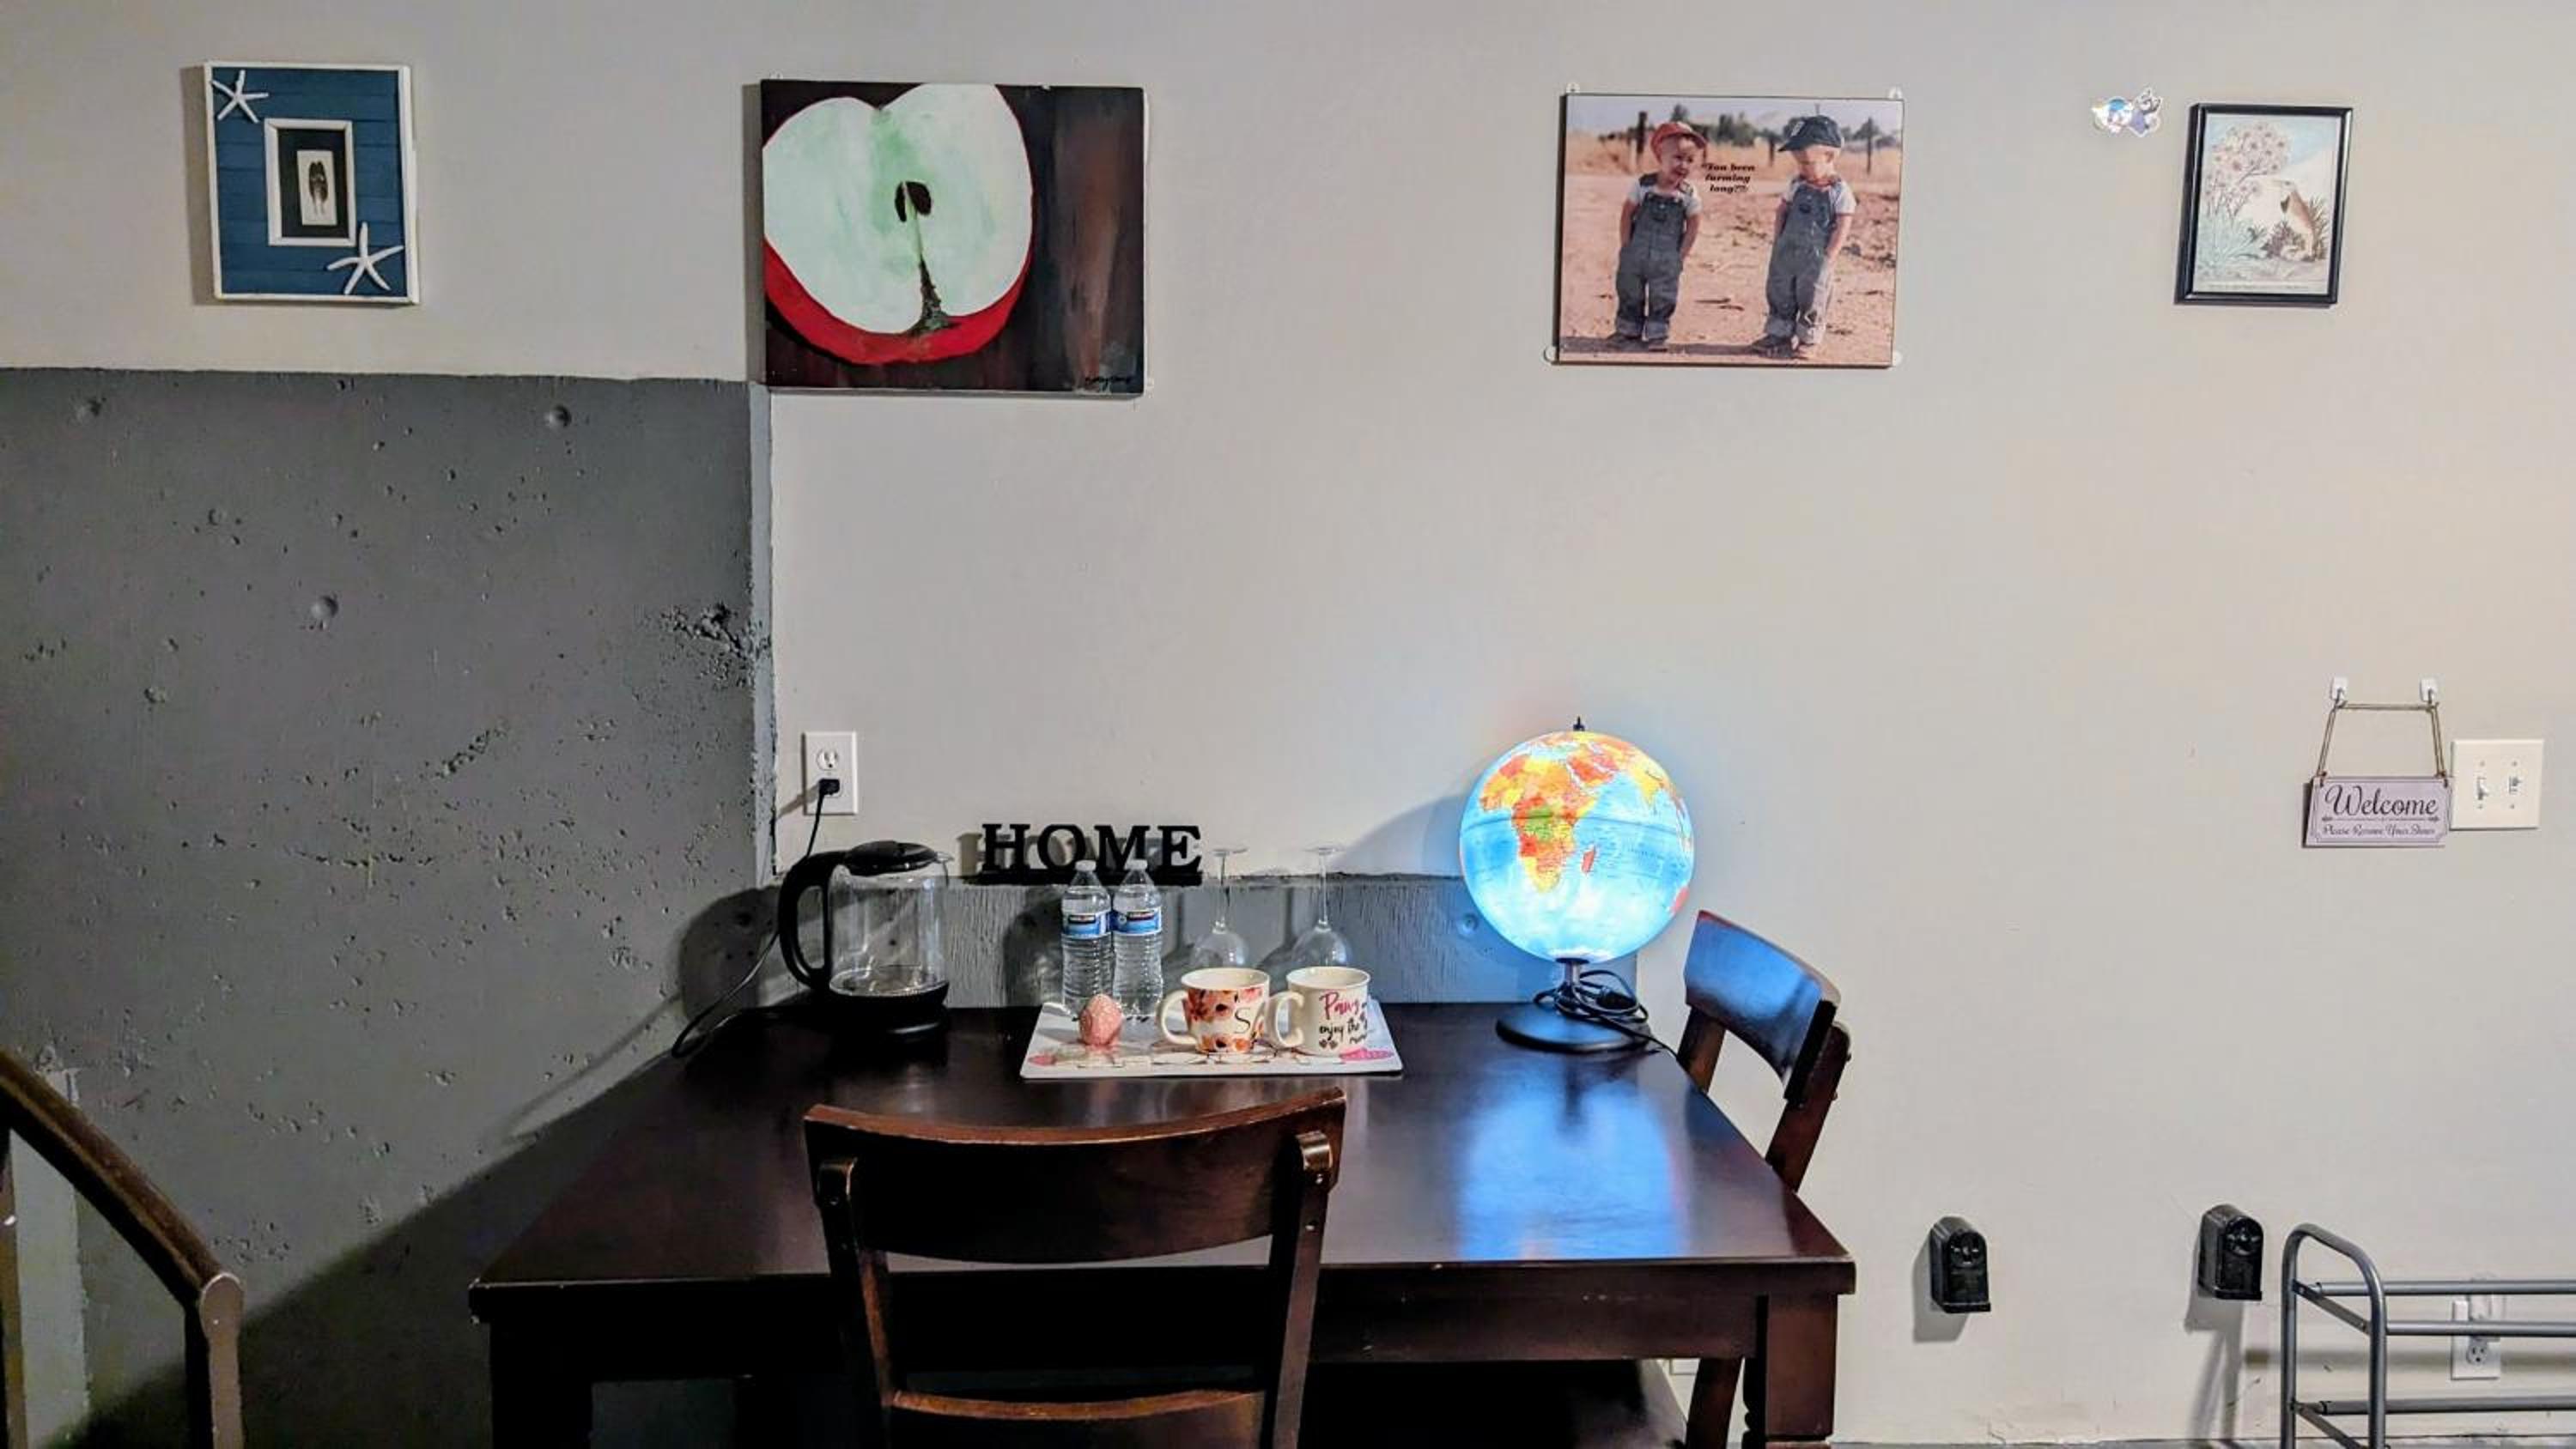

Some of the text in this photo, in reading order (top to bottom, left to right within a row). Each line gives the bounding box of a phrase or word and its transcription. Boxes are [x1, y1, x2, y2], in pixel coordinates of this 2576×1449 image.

[1705, 173, 1751, 184] farming
[1730, 163, 1755, 172] been
[2324, 785, 2439, 816] Welcome
[2322, 823, 2350, 836] Please
[2385, 823, 2409, 838] Your
[981, 823, 1202, 872] HOME
[1234, 1007, 1251, 1034] S
[1319, 1022, 1344, 1043] enjoy
[1346, 1017, 1360, 1034] the
